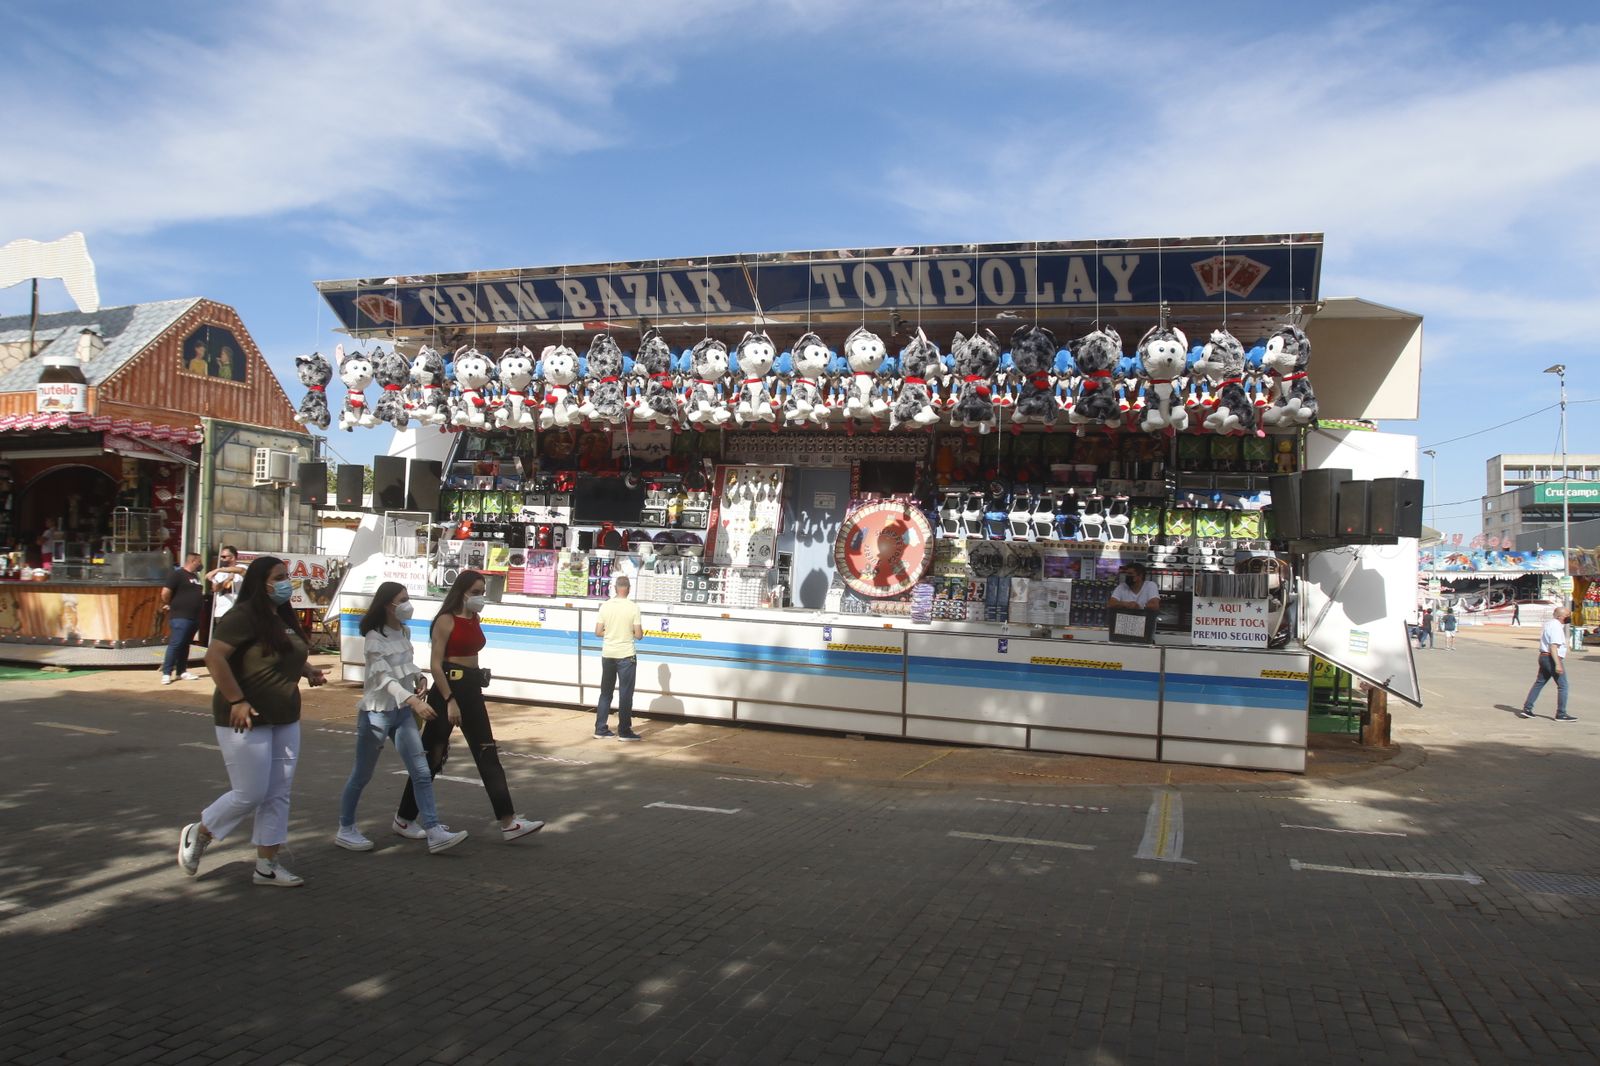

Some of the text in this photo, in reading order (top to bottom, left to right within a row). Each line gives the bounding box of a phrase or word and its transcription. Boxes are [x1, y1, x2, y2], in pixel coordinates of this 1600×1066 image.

[418, 255, 1139, 324] GRAN BAZAR TOMBOLAY
[399, 561, 412, 569] AQUI
[383, 571, 425, 580] SIEMPRE TOCA
[1219, 603, 1242, 613] AQUI
[1195, 617, 1265, 628] SIEMPRE TOCA
[1193, 630, 1267, 642] PREMIO SEGURO
